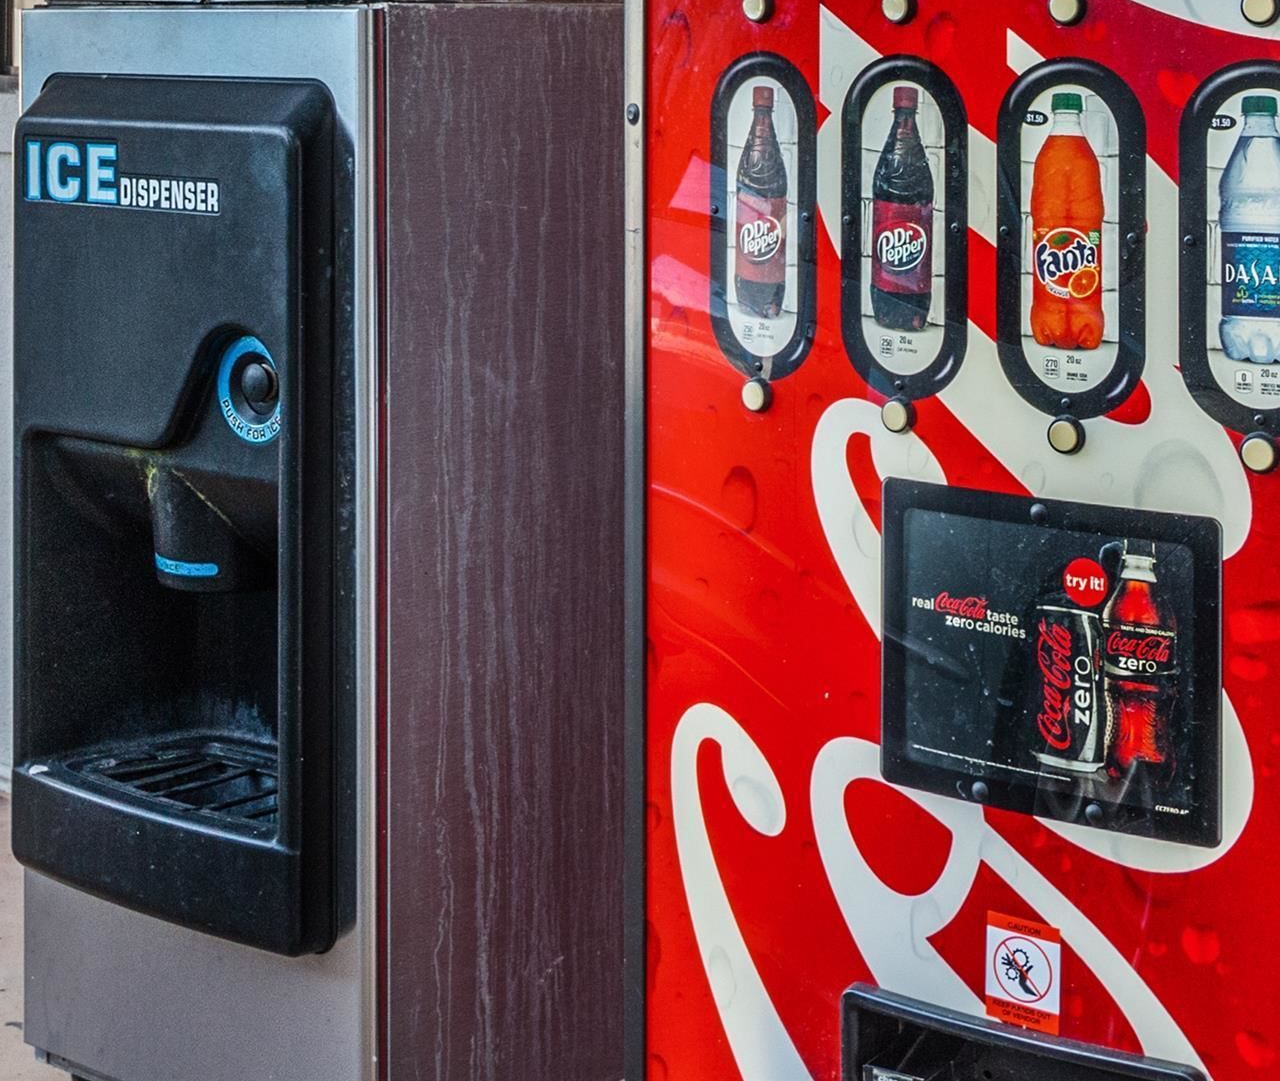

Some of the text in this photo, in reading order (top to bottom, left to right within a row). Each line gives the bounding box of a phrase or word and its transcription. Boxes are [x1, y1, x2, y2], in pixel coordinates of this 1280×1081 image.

[1025, 113, 1044, 123] $1.50
[1211, 118, 1231, 128] $1.50
[26, 140, 219, 213] ICE DISPENSER
[754, 220, 770, 238] Dr
[893, 228, 913, 247] Dr
[743, 223, 778, 256] Pepper
[881, 231, 923, 265] Pepper
[1045, 358, 1058, 368] 270
[1066, 354, 1075, 364] 20
[1260, 368, 1270, 378] 20
[222, 399, 244, 433] PUSH
[246, 428, 266, 440] FOR
[1065, 574, 1105, 591] try it!
[912, 591, 1019, 625] real Coca-Cola taste
[945, 615, 1026, 639] zero calories
[1106, 631, 1170, 662] Coca-Cola
[1118, 656, 1157, 672] zero
[1037, 616, 1071, 750] Coca-Cola
[1074, 656, 1091, 726] zero
[1007, 921, 1041, 935] CAUTION
[992, 1000, 1009, 1008] KEEP
